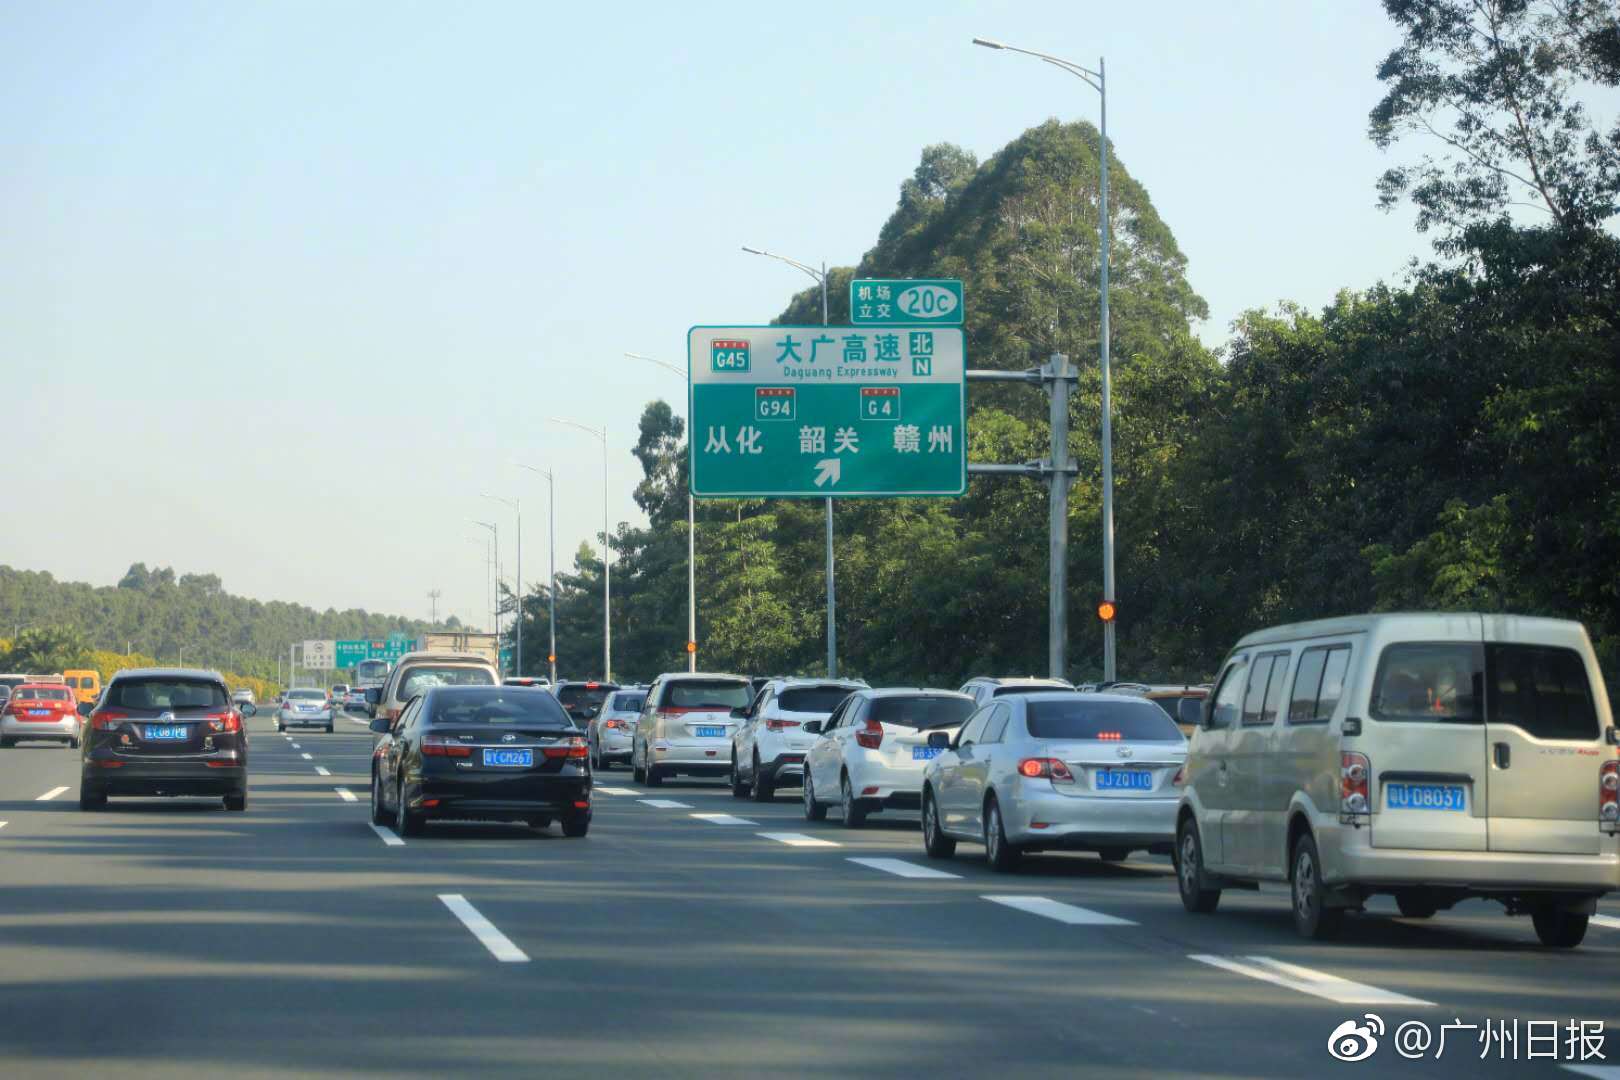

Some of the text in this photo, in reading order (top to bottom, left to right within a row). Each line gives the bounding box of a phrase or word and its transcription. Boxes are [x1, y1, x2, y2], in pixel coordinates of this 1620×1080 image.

[857, 285, 891, 301] 机场
[858, 304, 891, 318] 立交
[776, 333, 902, 364] 大广高速
[912, 334, 932, 354] 北
[716, 352, 746, 369] G45
[915, 360, 929, 375] N
[783, 366, 898, 380] Daguang Expressway
[759, 400, 791, 416] G94
[704, 425, 764, 455] 从化
[798, 425, 860, 455] 韶关
[892, 424, 954, 455] 赣州
